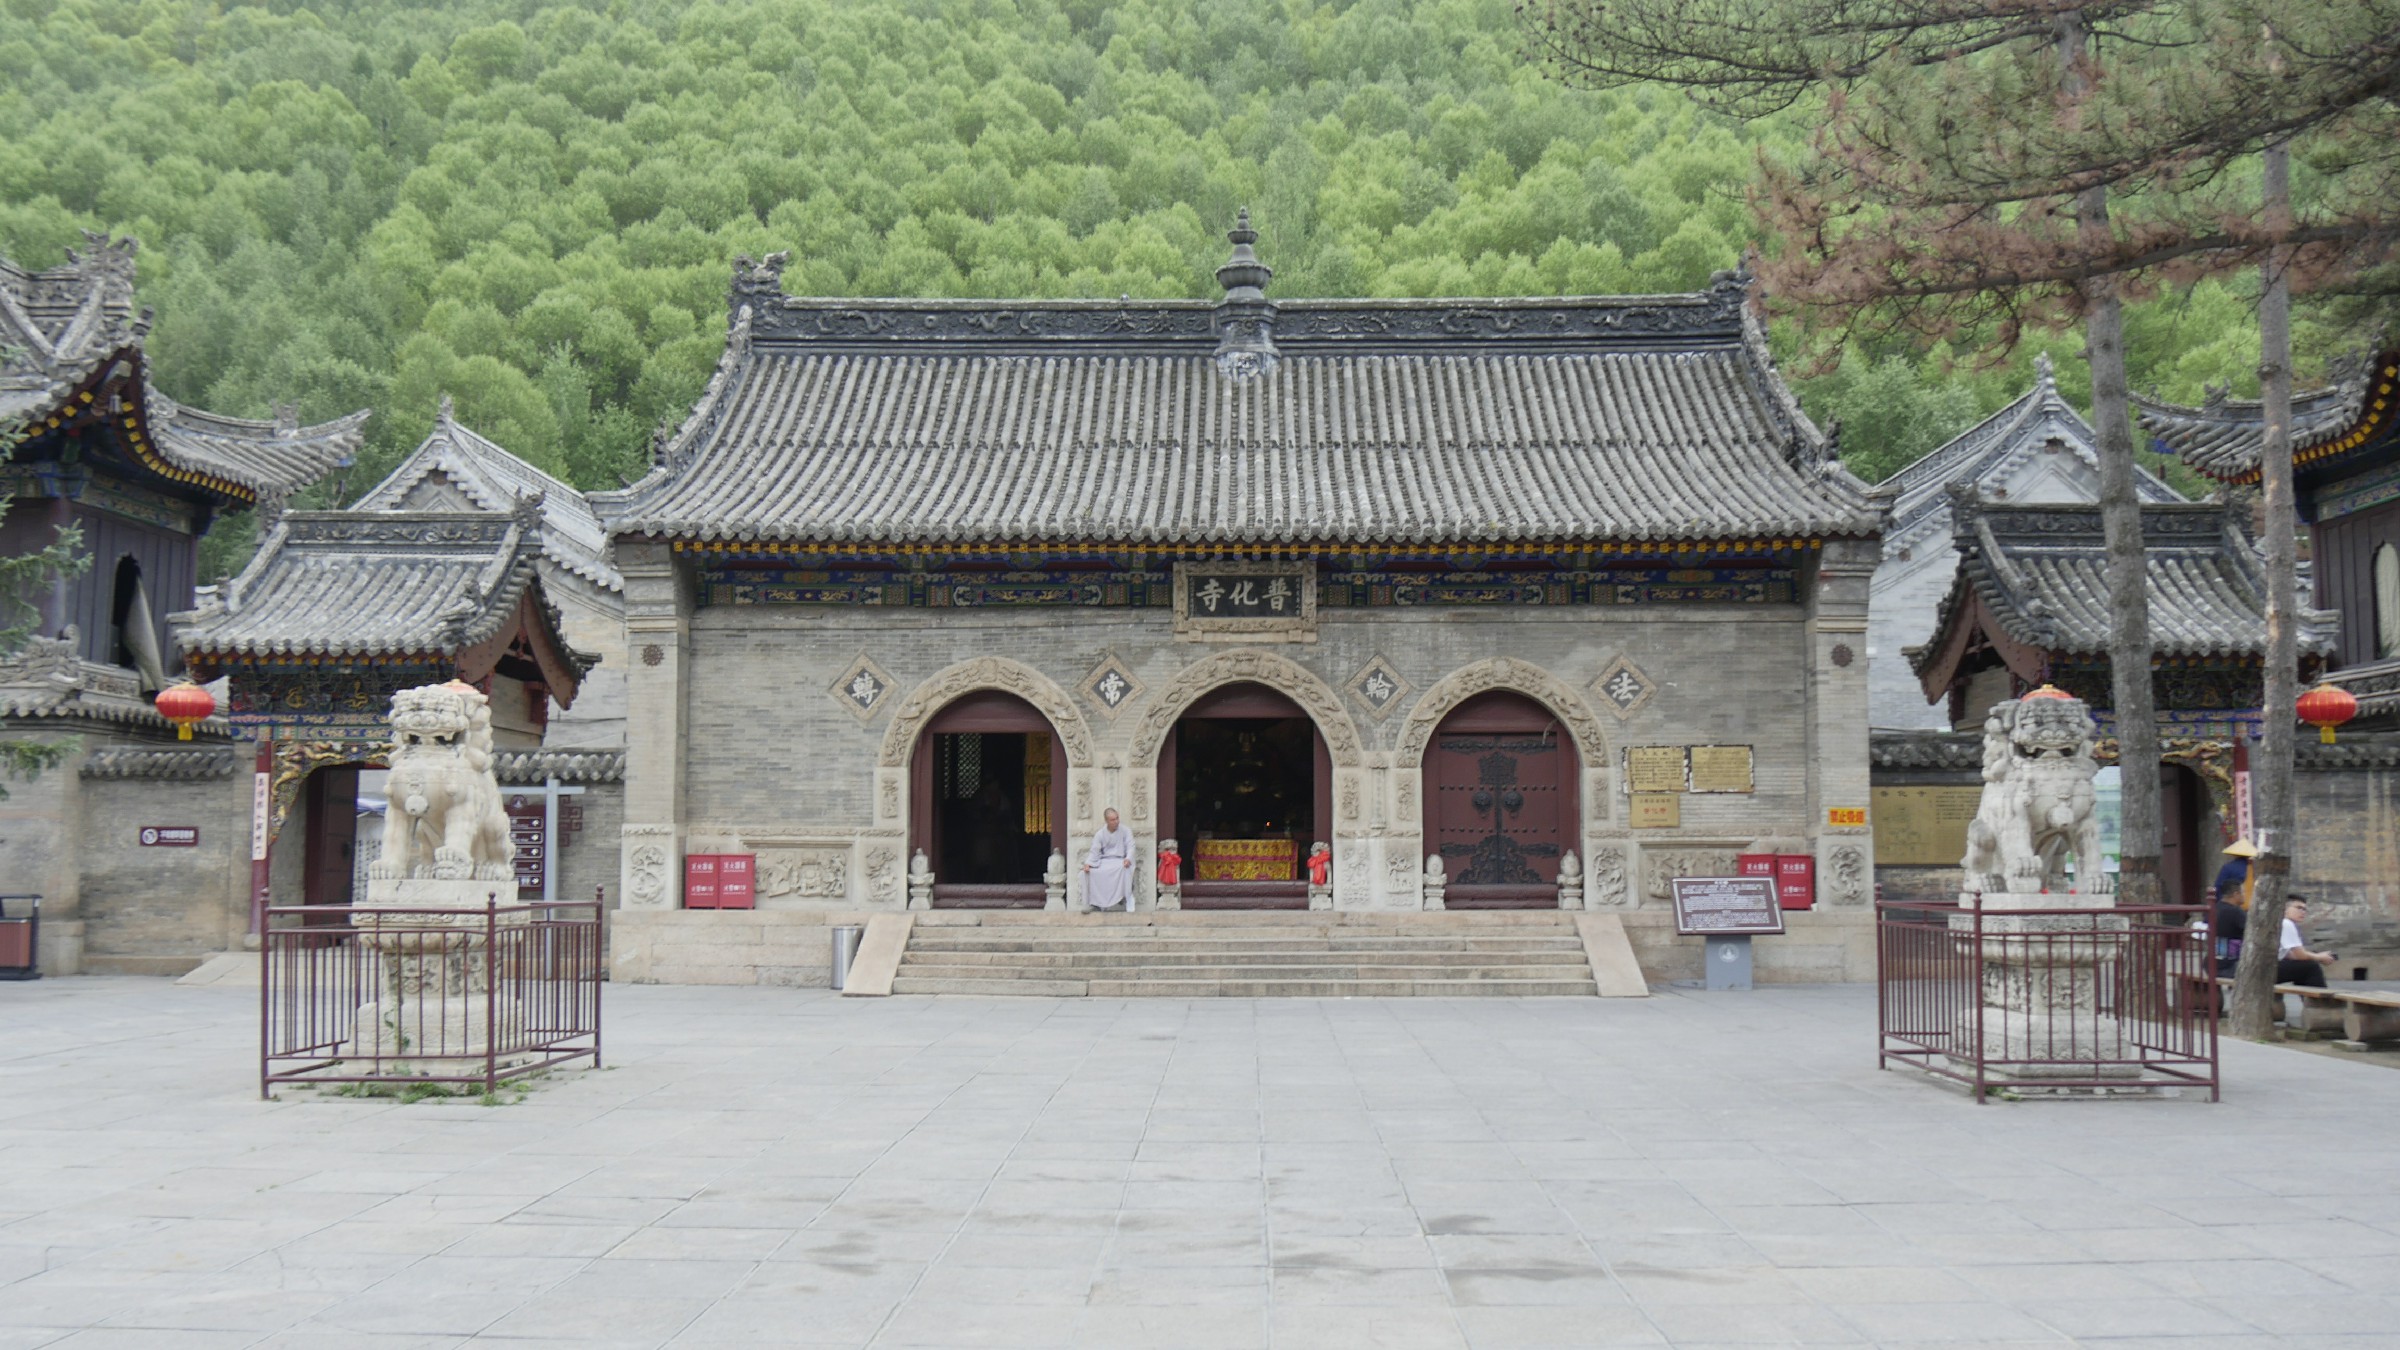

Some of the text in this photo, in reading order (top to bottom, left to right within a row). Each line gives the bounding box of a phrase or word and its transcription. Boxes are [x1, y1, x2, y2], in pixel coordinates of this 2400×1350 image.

[851, 672, 878, 704] 轉
[1099, 672, 1125, 705] 常
[1365, 671, 1393, 701] 輪
[1609, 671, 1640, 701] 法
